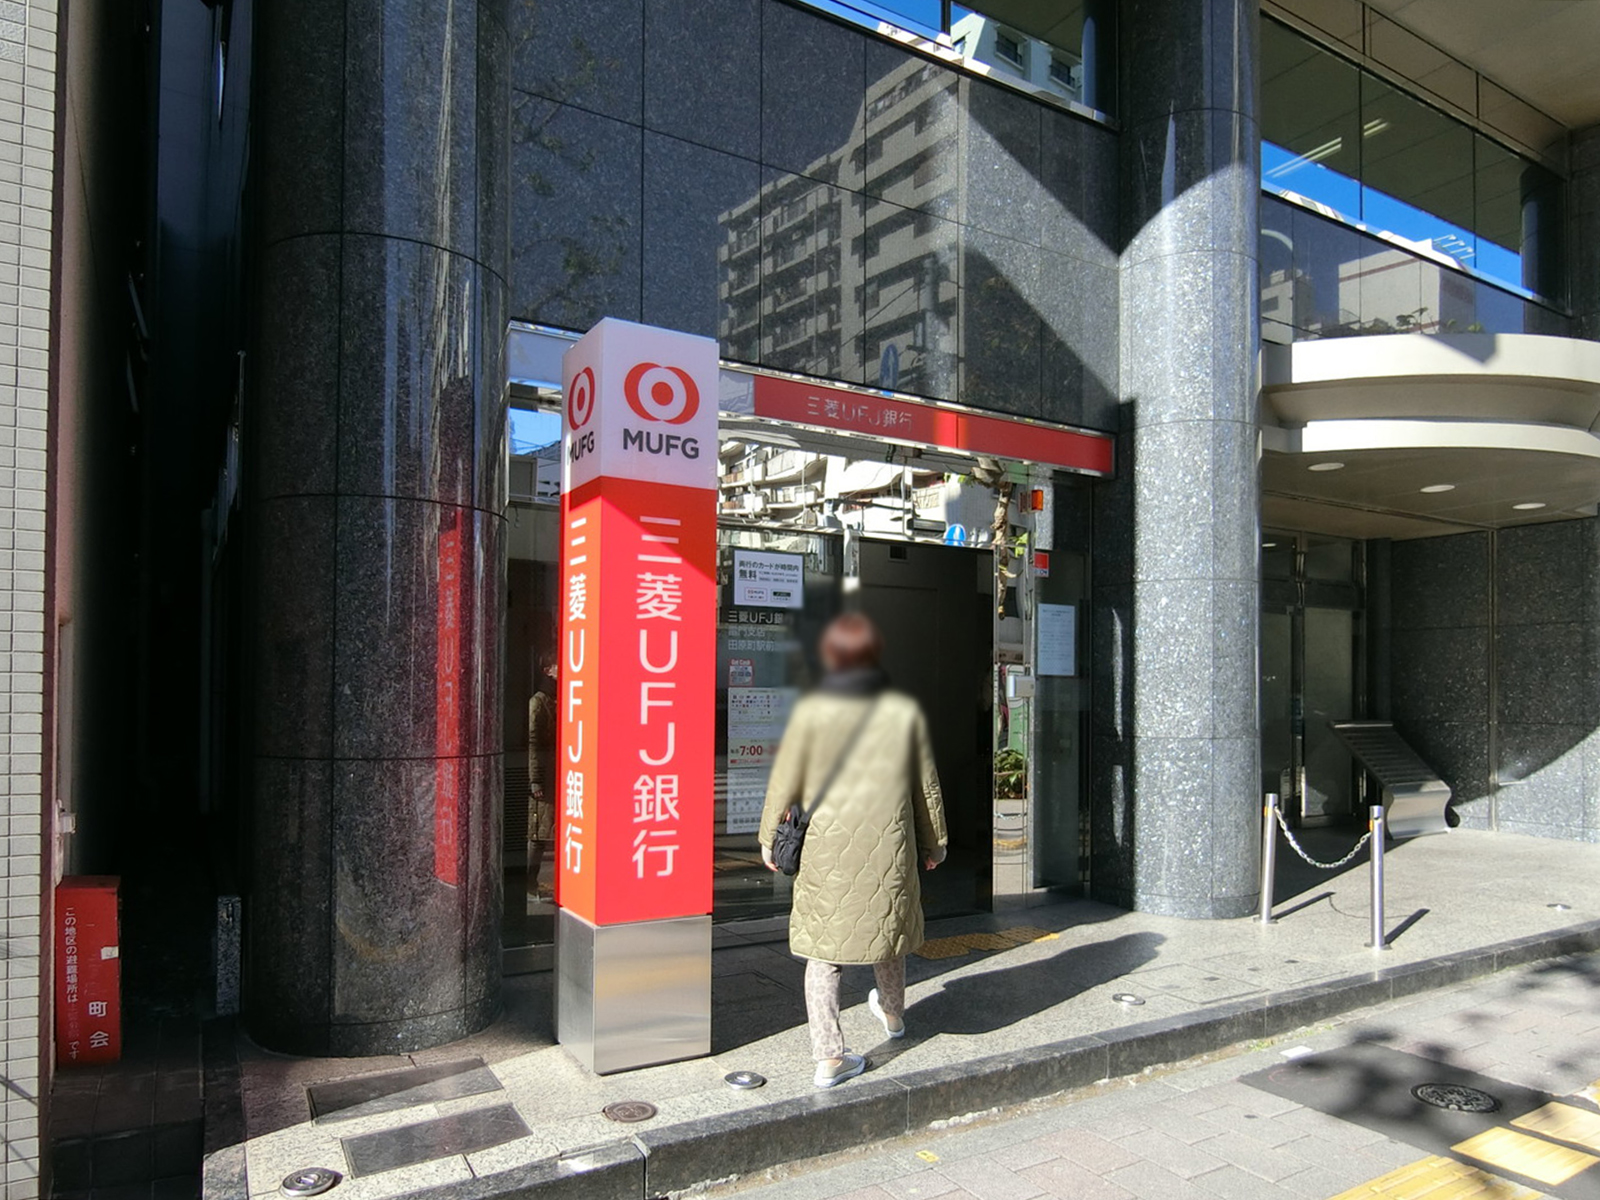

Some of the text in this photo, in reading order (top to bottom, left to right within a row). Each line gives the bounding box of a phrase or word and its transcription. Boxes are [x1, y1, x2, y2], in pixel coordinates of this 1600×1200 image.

[807, 396, 913, 432] 三菱UFJ銀行
[567, 431, 595, 465] MUFG
[622, 428, 700, 459] MUFG
[728, 639, 800, 652] 田原町駅前
[565, 517, 588, 875] 三菱UFJ銀行
[632, 515, 682, 879] 三菱UFJ銀行
[740, 745, 763, 756] 7:00
